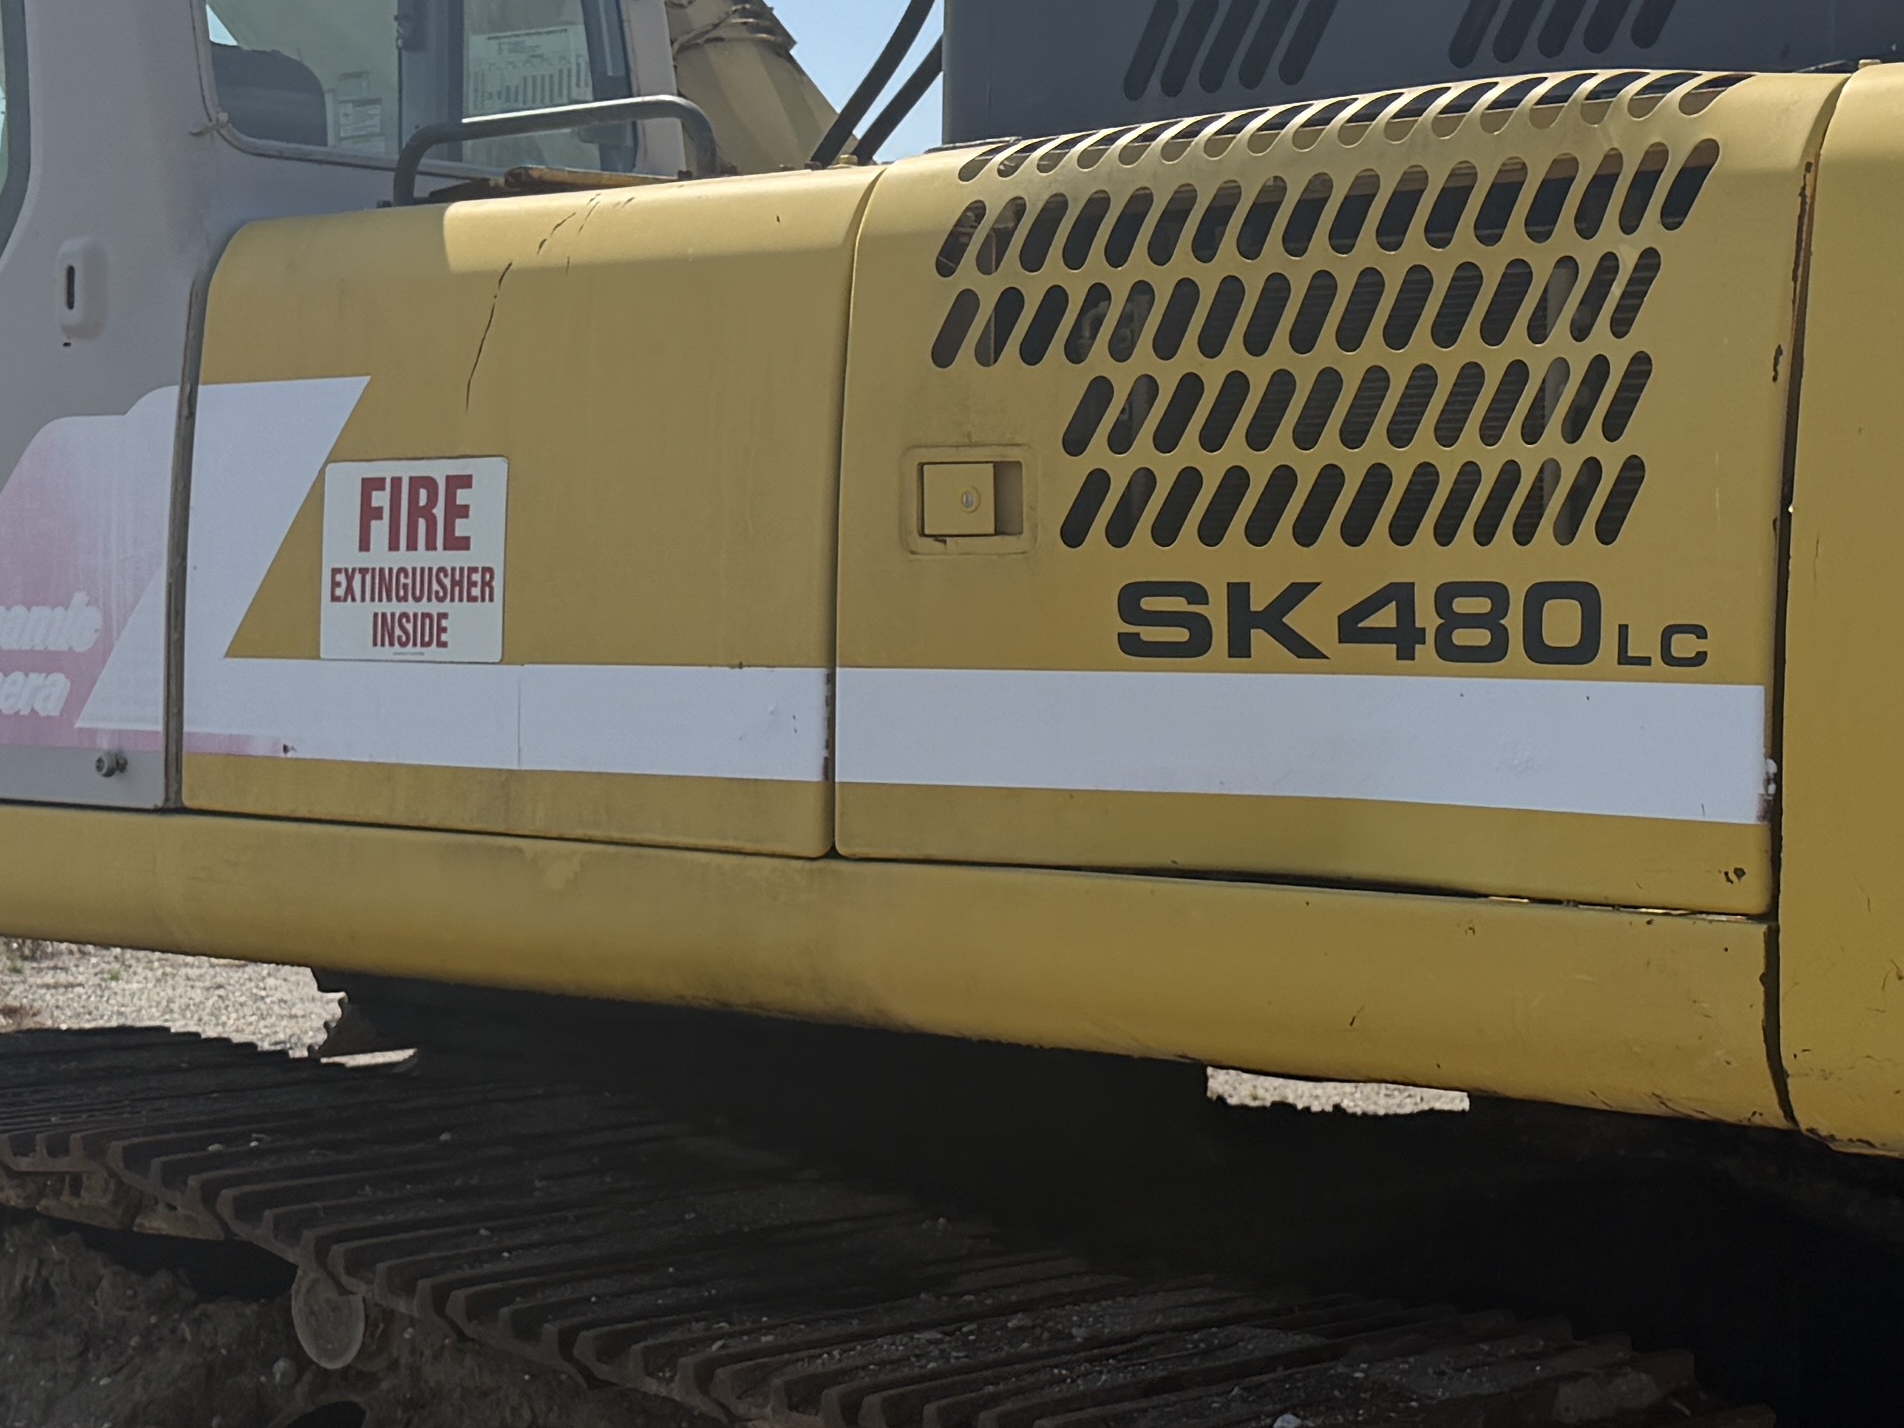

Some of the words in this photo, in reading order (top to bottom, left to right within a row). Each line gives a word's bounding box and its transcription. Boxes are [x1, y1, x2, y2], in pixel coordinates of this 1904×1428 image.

[358, 474, 473, 552] FIRE
[330, 566, 495, 603] EXTINGUISHER
[372, 611, 449, 648] INSIDE
